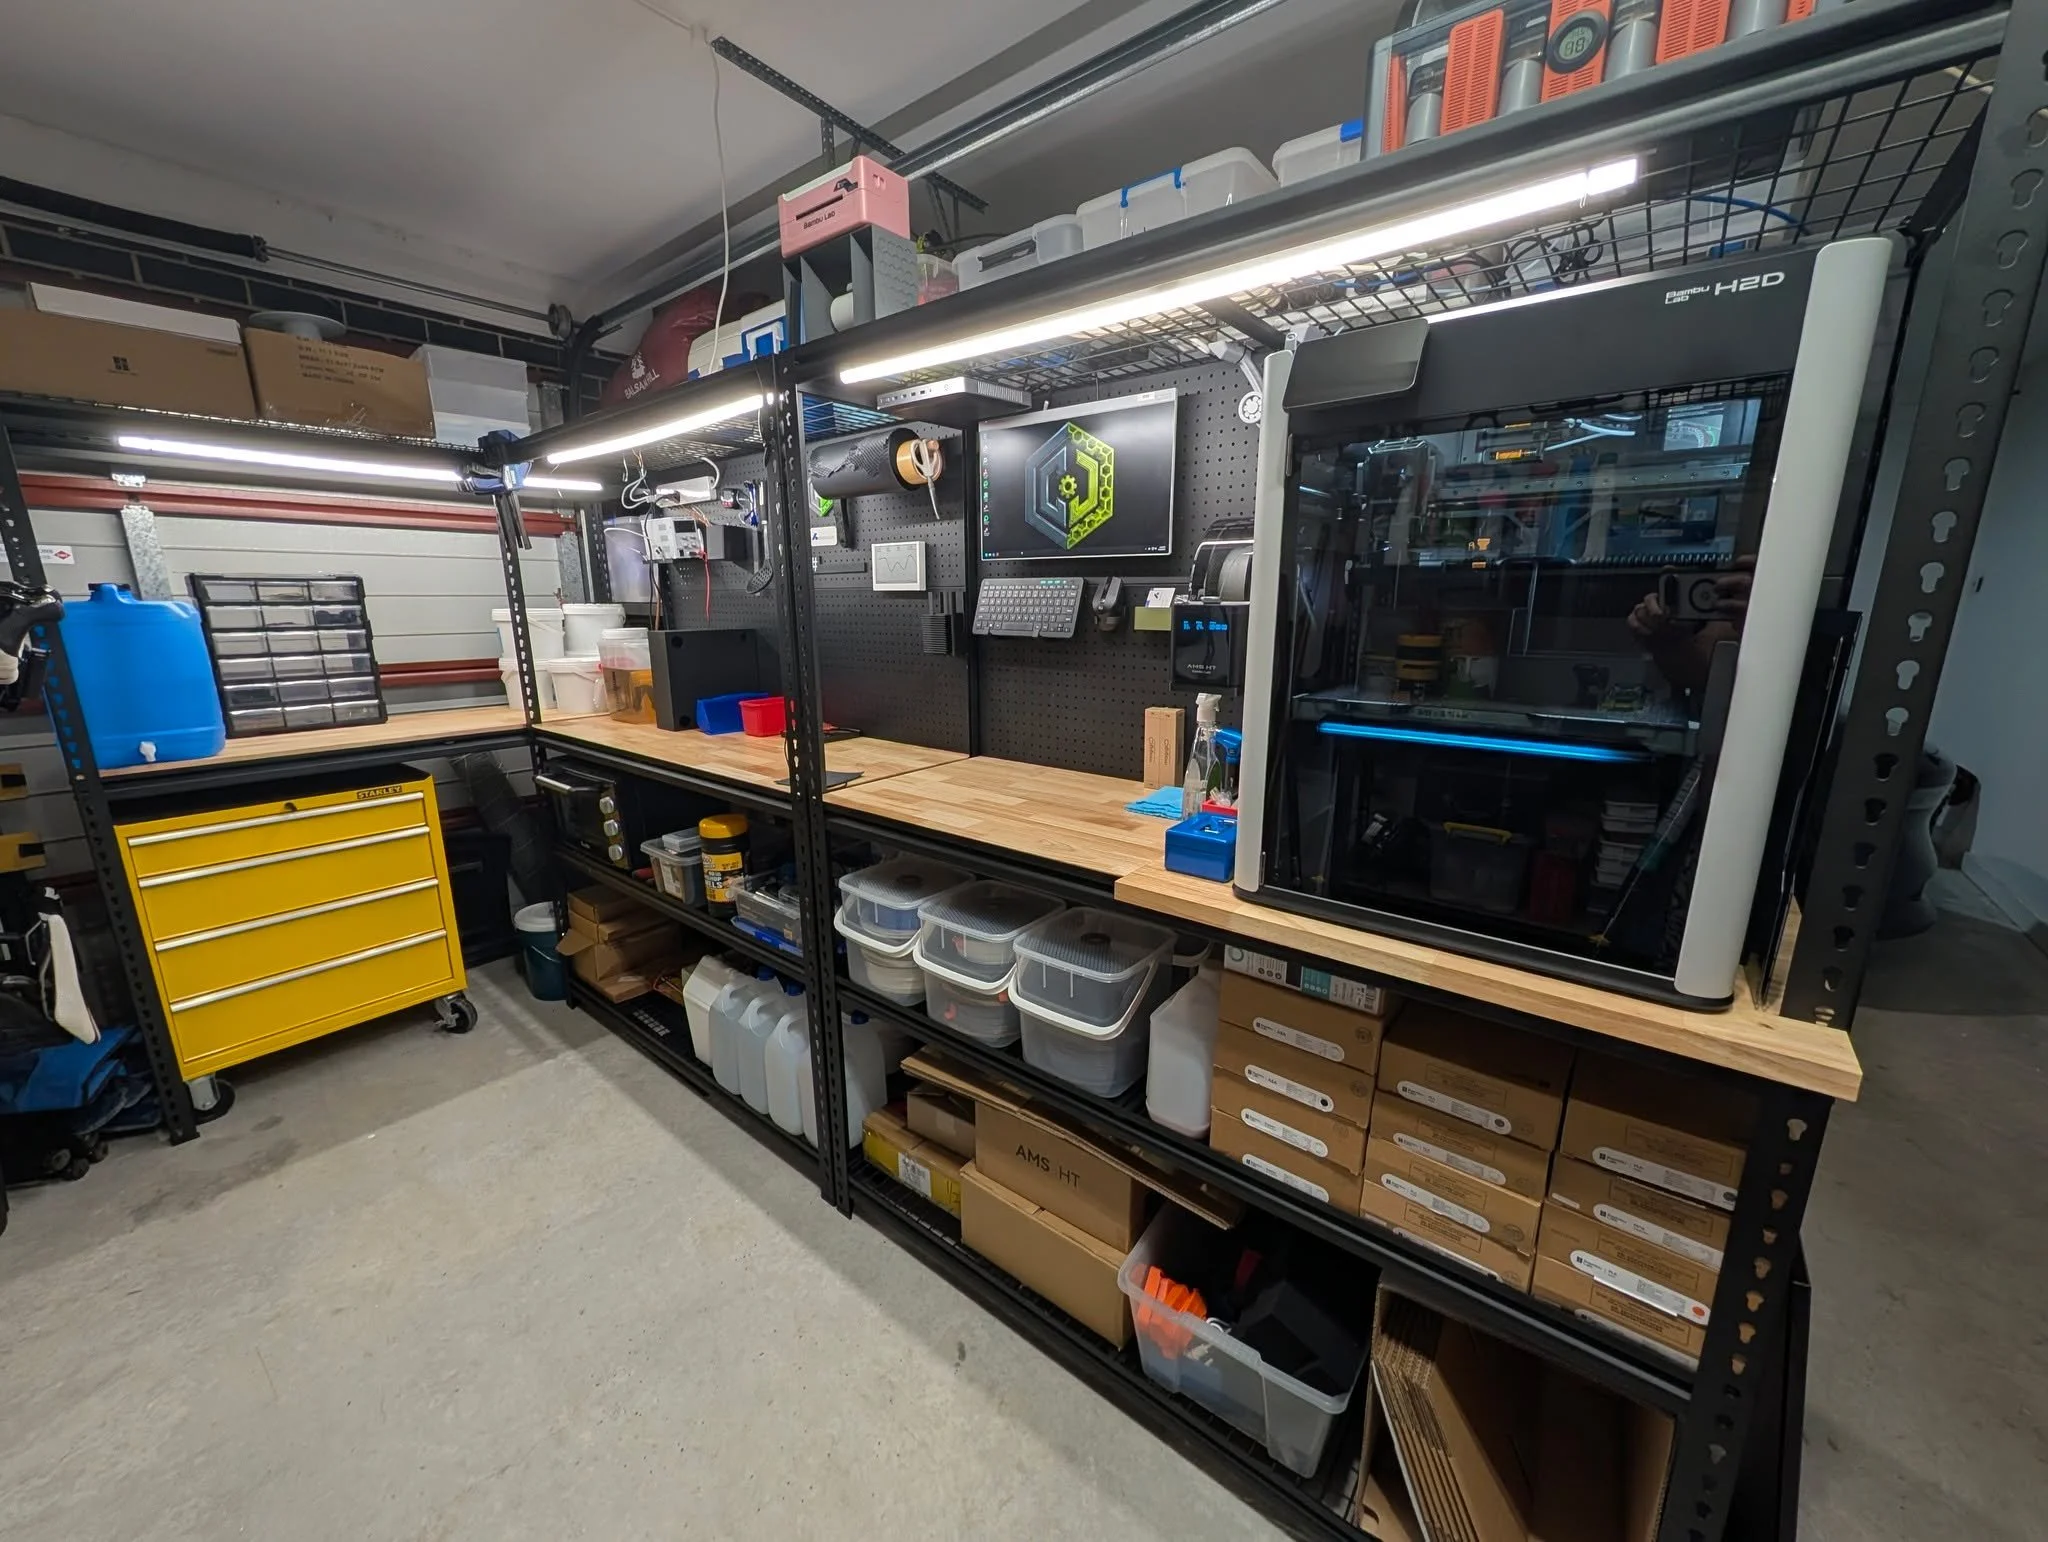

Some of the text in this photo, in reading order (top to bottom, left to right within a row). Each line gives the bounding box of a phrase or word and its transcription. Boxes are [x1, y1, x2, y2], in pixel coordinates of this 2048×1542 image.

[1714, 271, 1785, 296] H2D
[1666, 285, 1710, 298] Bambu
[1665, 295, 1690, 305] Lab
[358, 786, 402, 799] STANLEY
[1015, 1144, 1081, 1188] AMS HT
